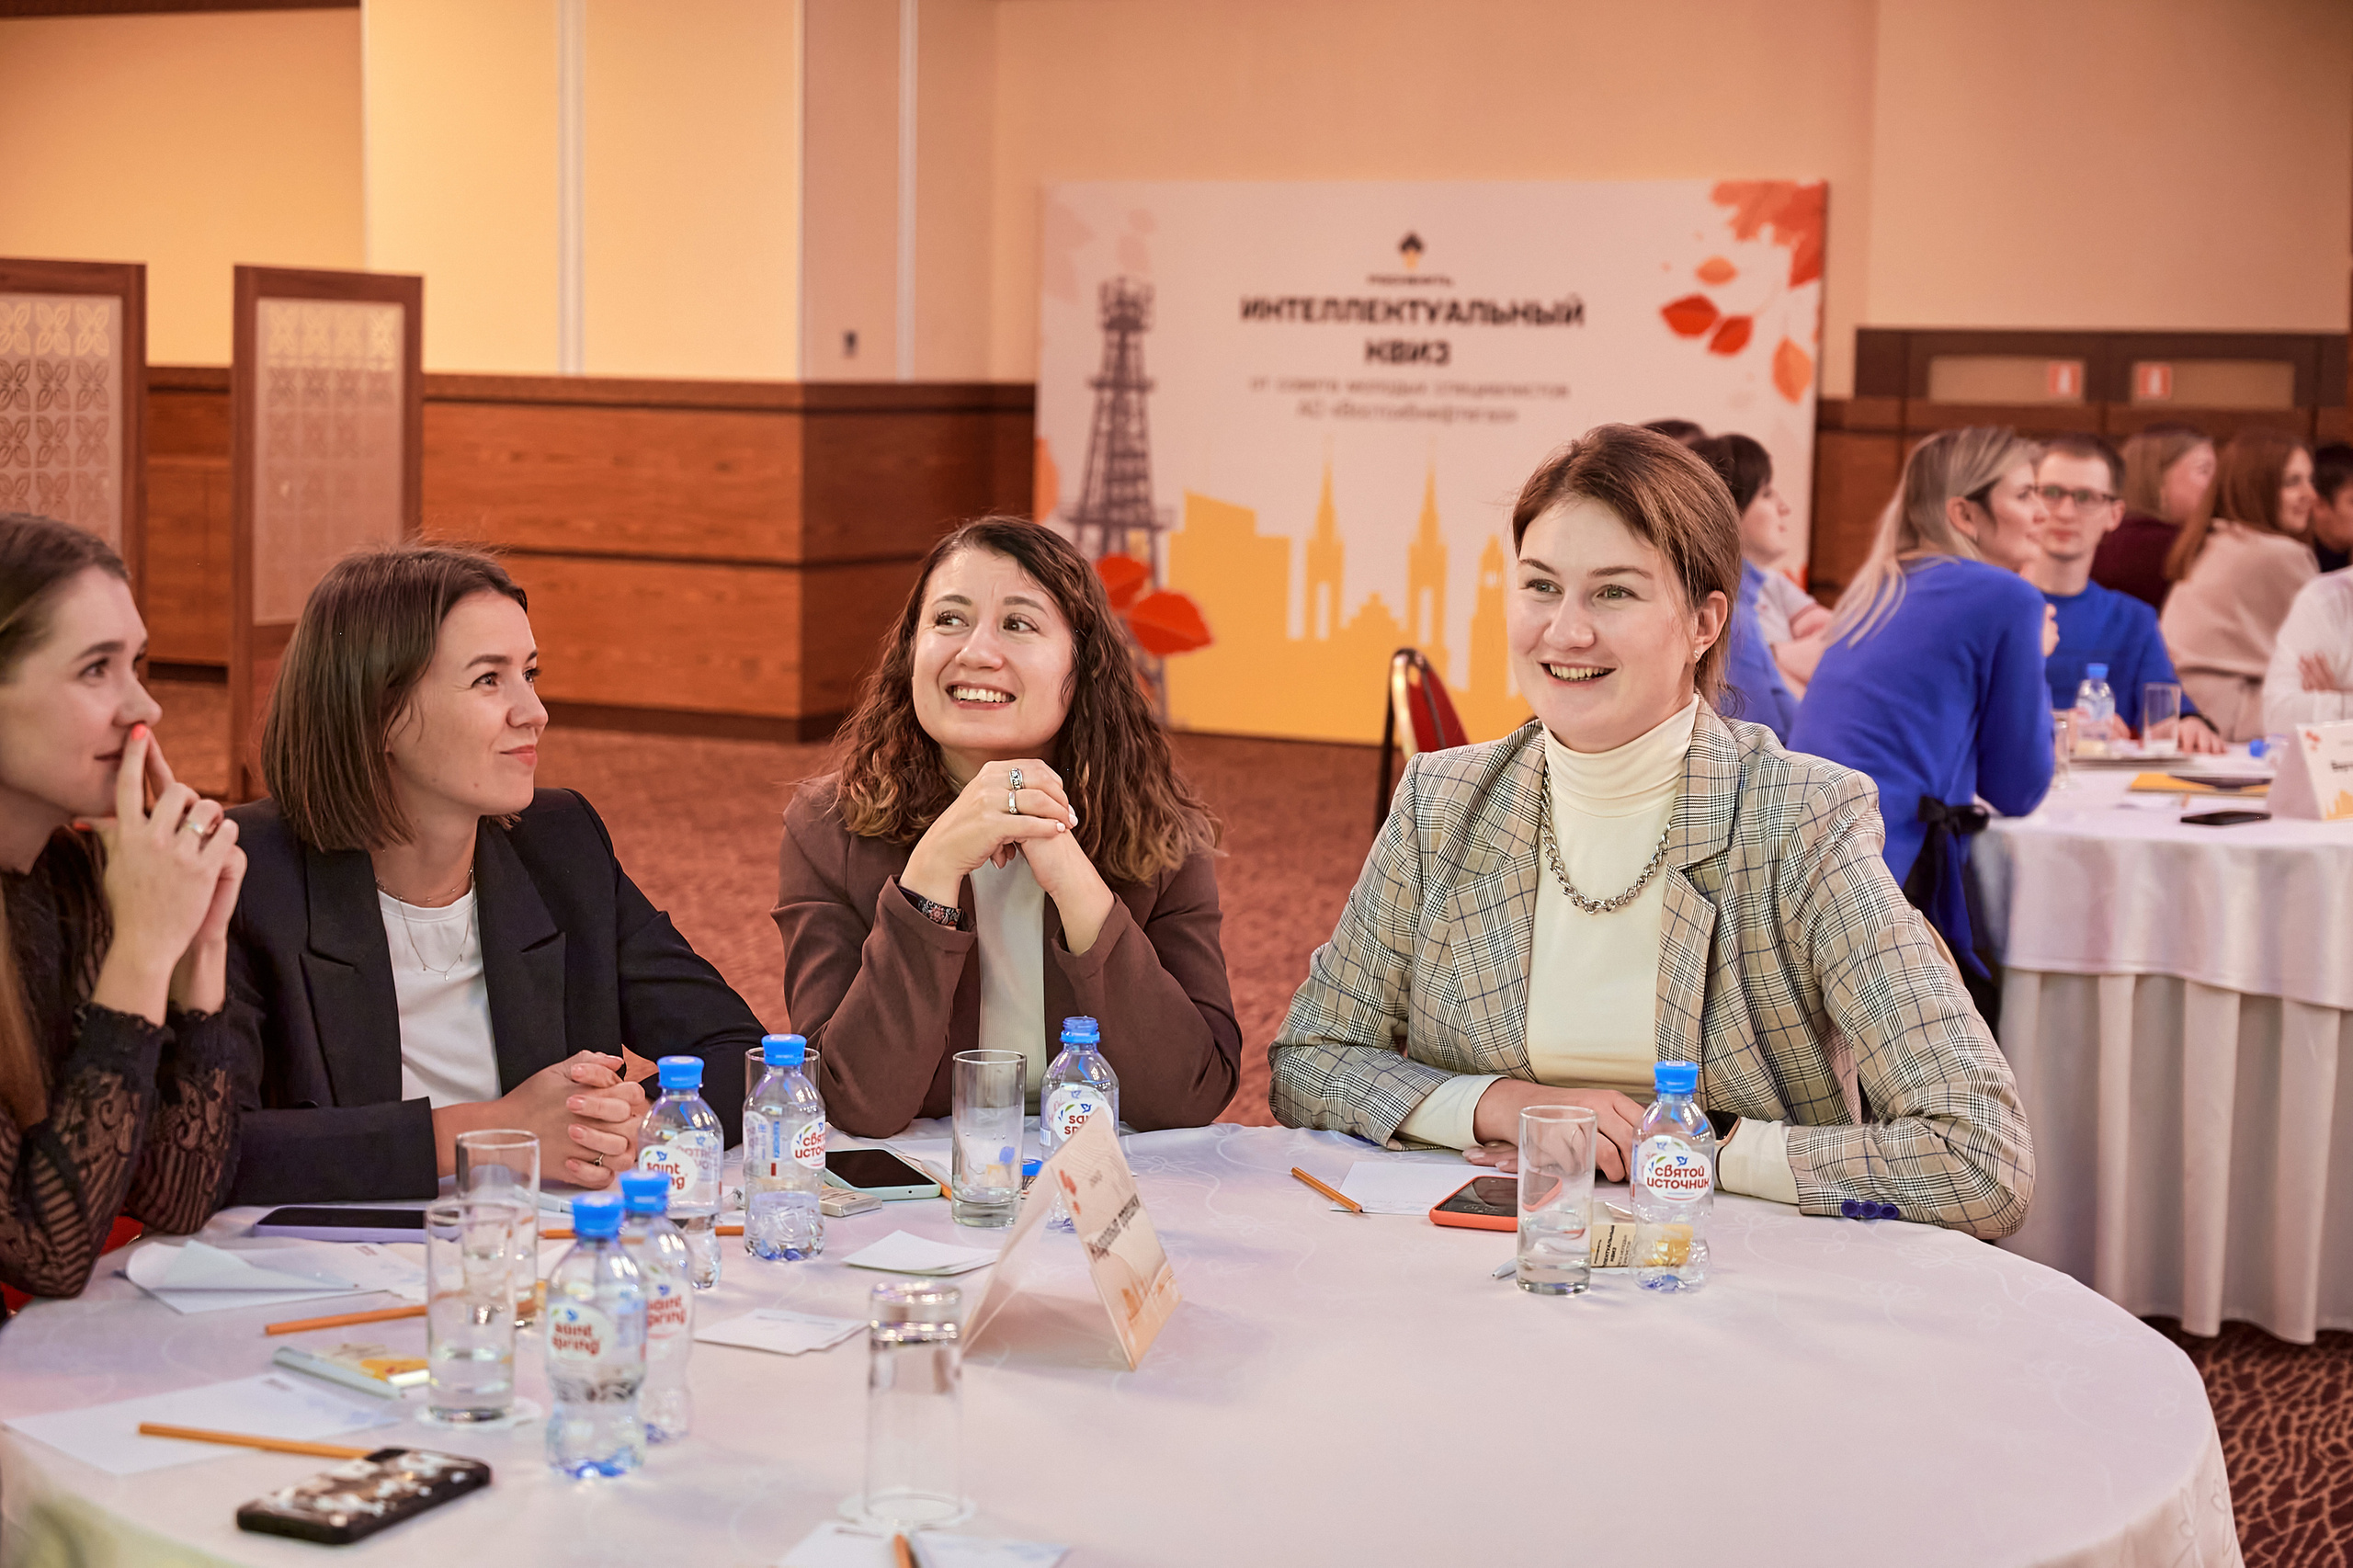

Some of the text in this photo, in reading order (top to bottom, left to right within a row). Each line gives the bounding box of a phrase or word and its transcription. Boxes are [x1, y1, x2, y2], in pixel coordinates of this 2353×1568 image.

[1240, 292, 1586, 324] ИНТЕЛЛЕКТУАЛЬНЫЙ
[1364, 341, 1449, 365] КВИЗ
[1654, 1165, 1705, 1178] святой
[1646, 1176, 1710, 1189] источник
[647, 1309, 687, 1328] pring
[554, 1324, 593, 1336] saint
[551, 1336, 600, 1356] spring
